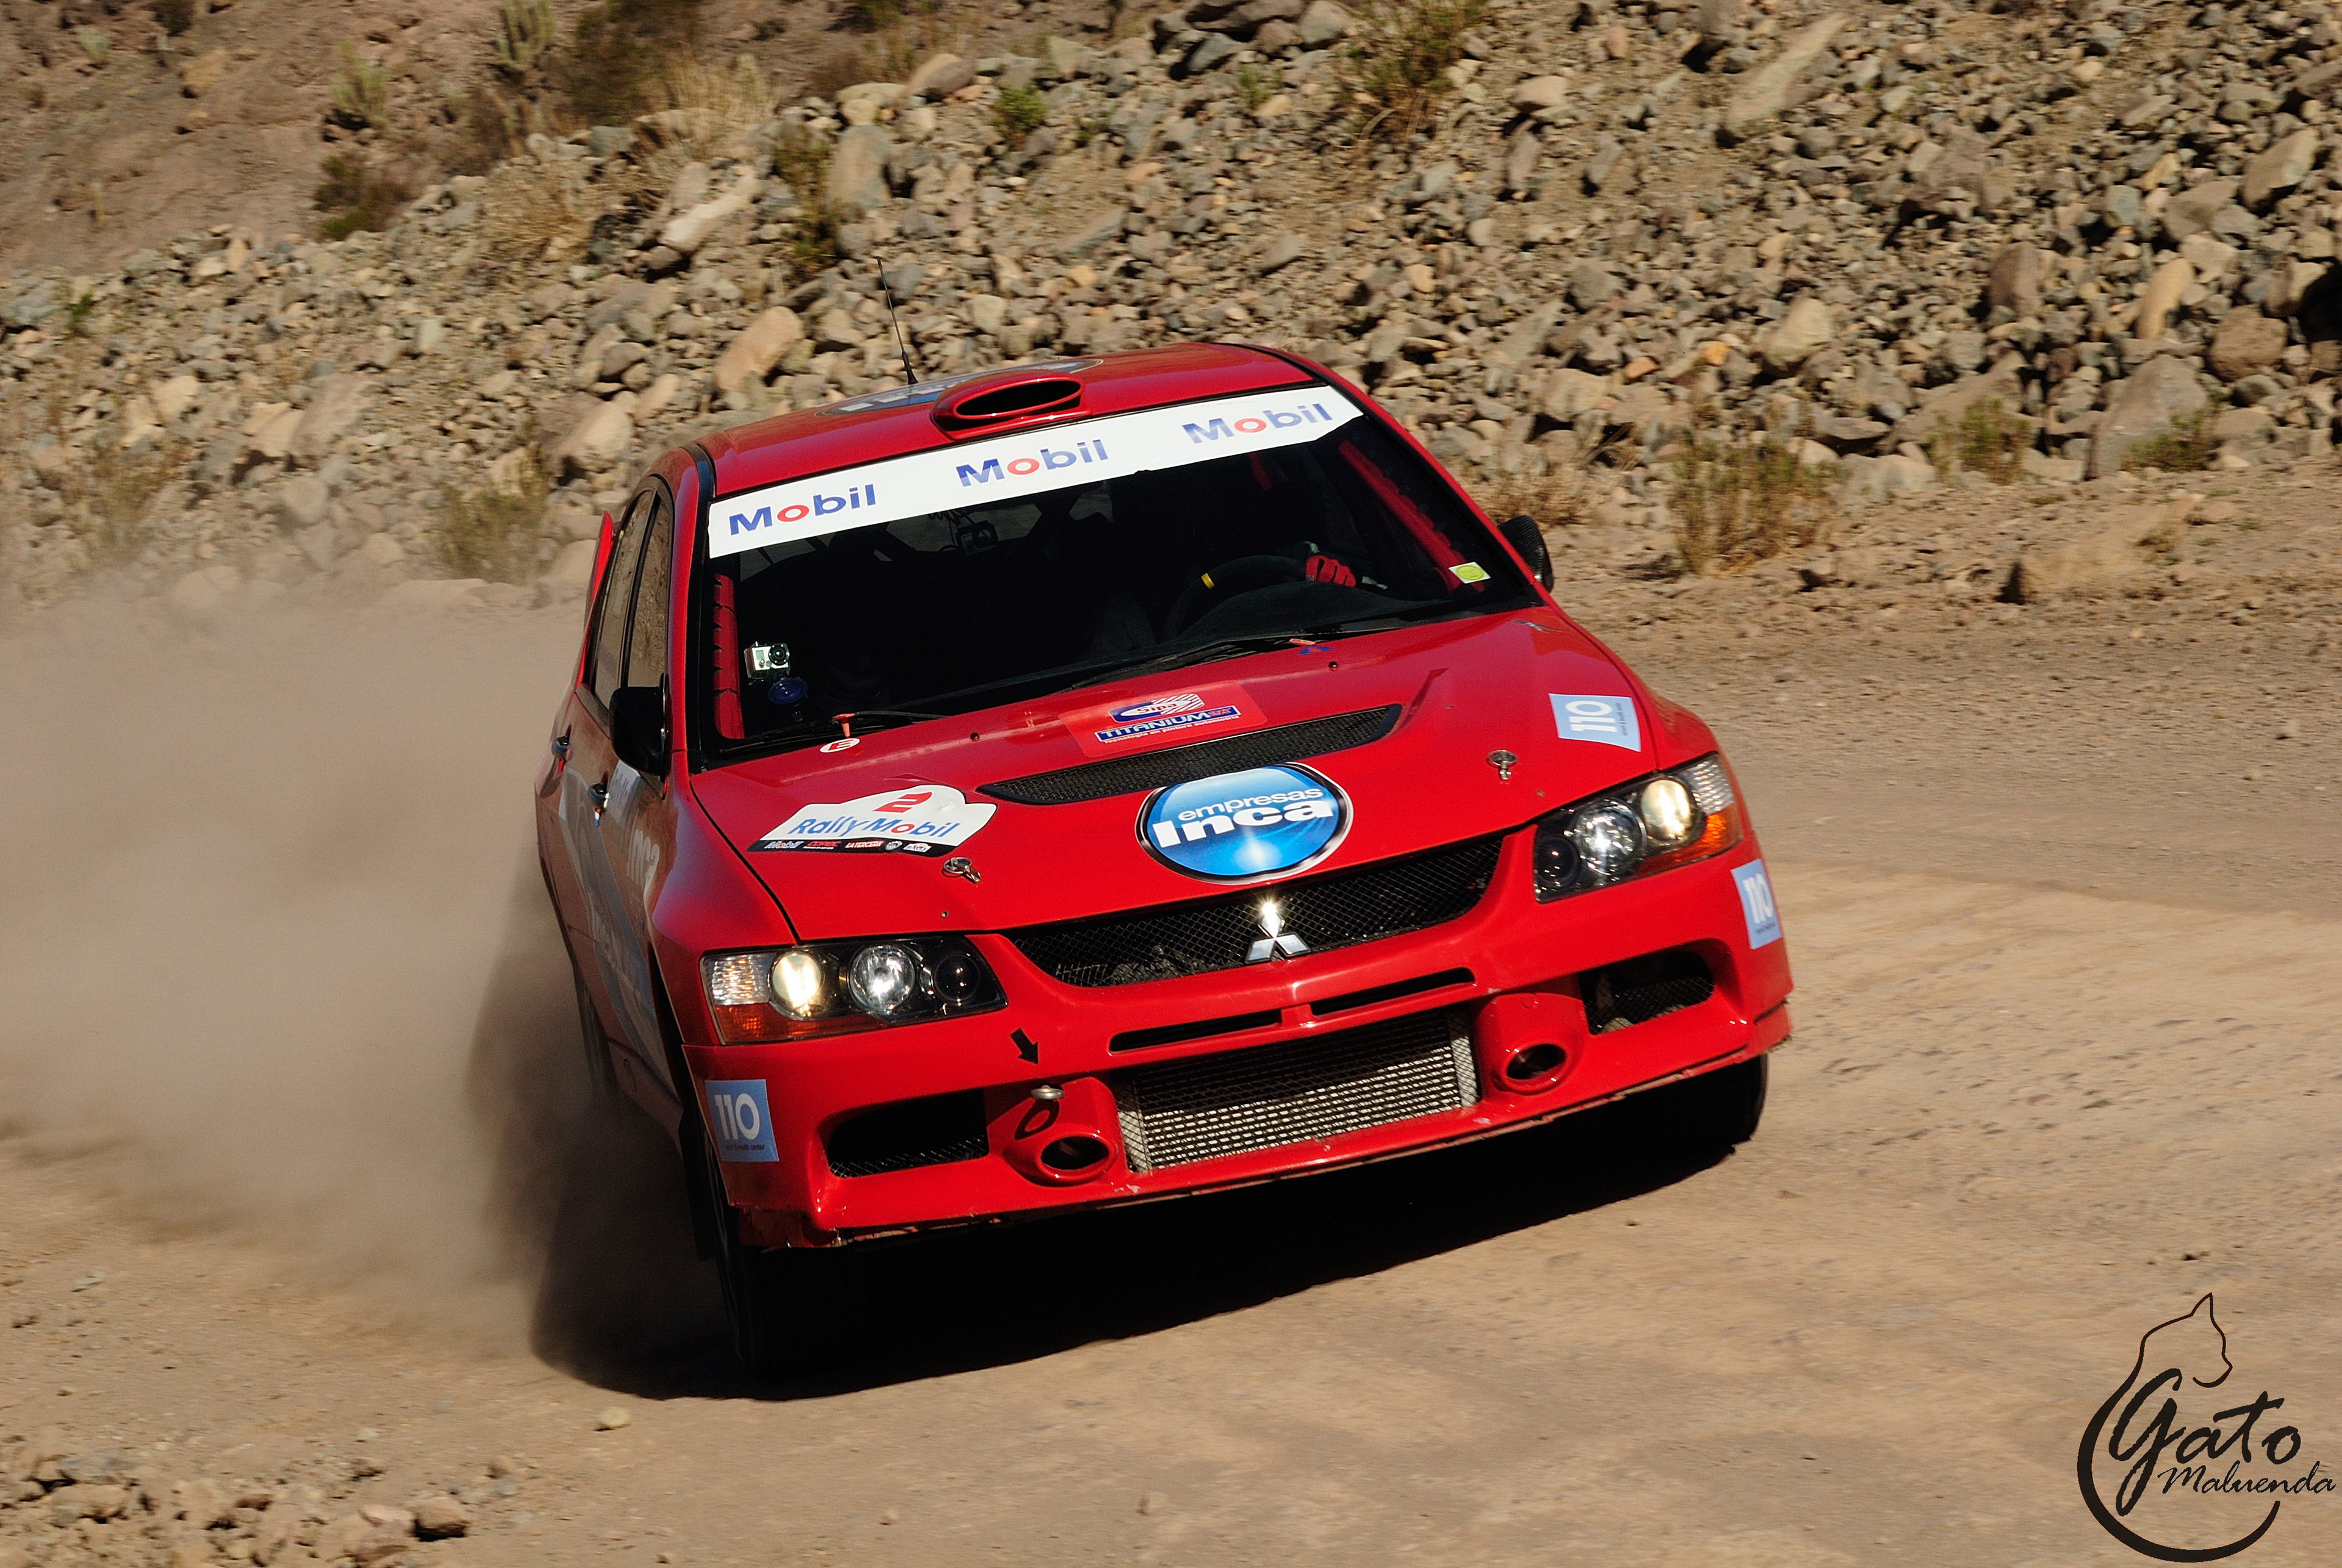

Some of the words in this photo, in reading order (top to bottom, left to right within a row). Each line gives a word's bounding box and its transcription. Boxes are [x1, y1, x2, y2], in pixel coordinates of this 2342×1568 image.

[1181, 403, 1334, 446] Mobil
[956, 439, 1109, 487] Mobil
[729, 484, 876, 536] Mobil
[1565, 700, 1618, 732] 110
[872, 792, 933, 814] 2
[1152, 800, 1334, 848] Inca
[1178, 788, 1324, 822] empresas
[764, 840, 804, 849] Mobil
[714, 1093, 760, 1140] 110
